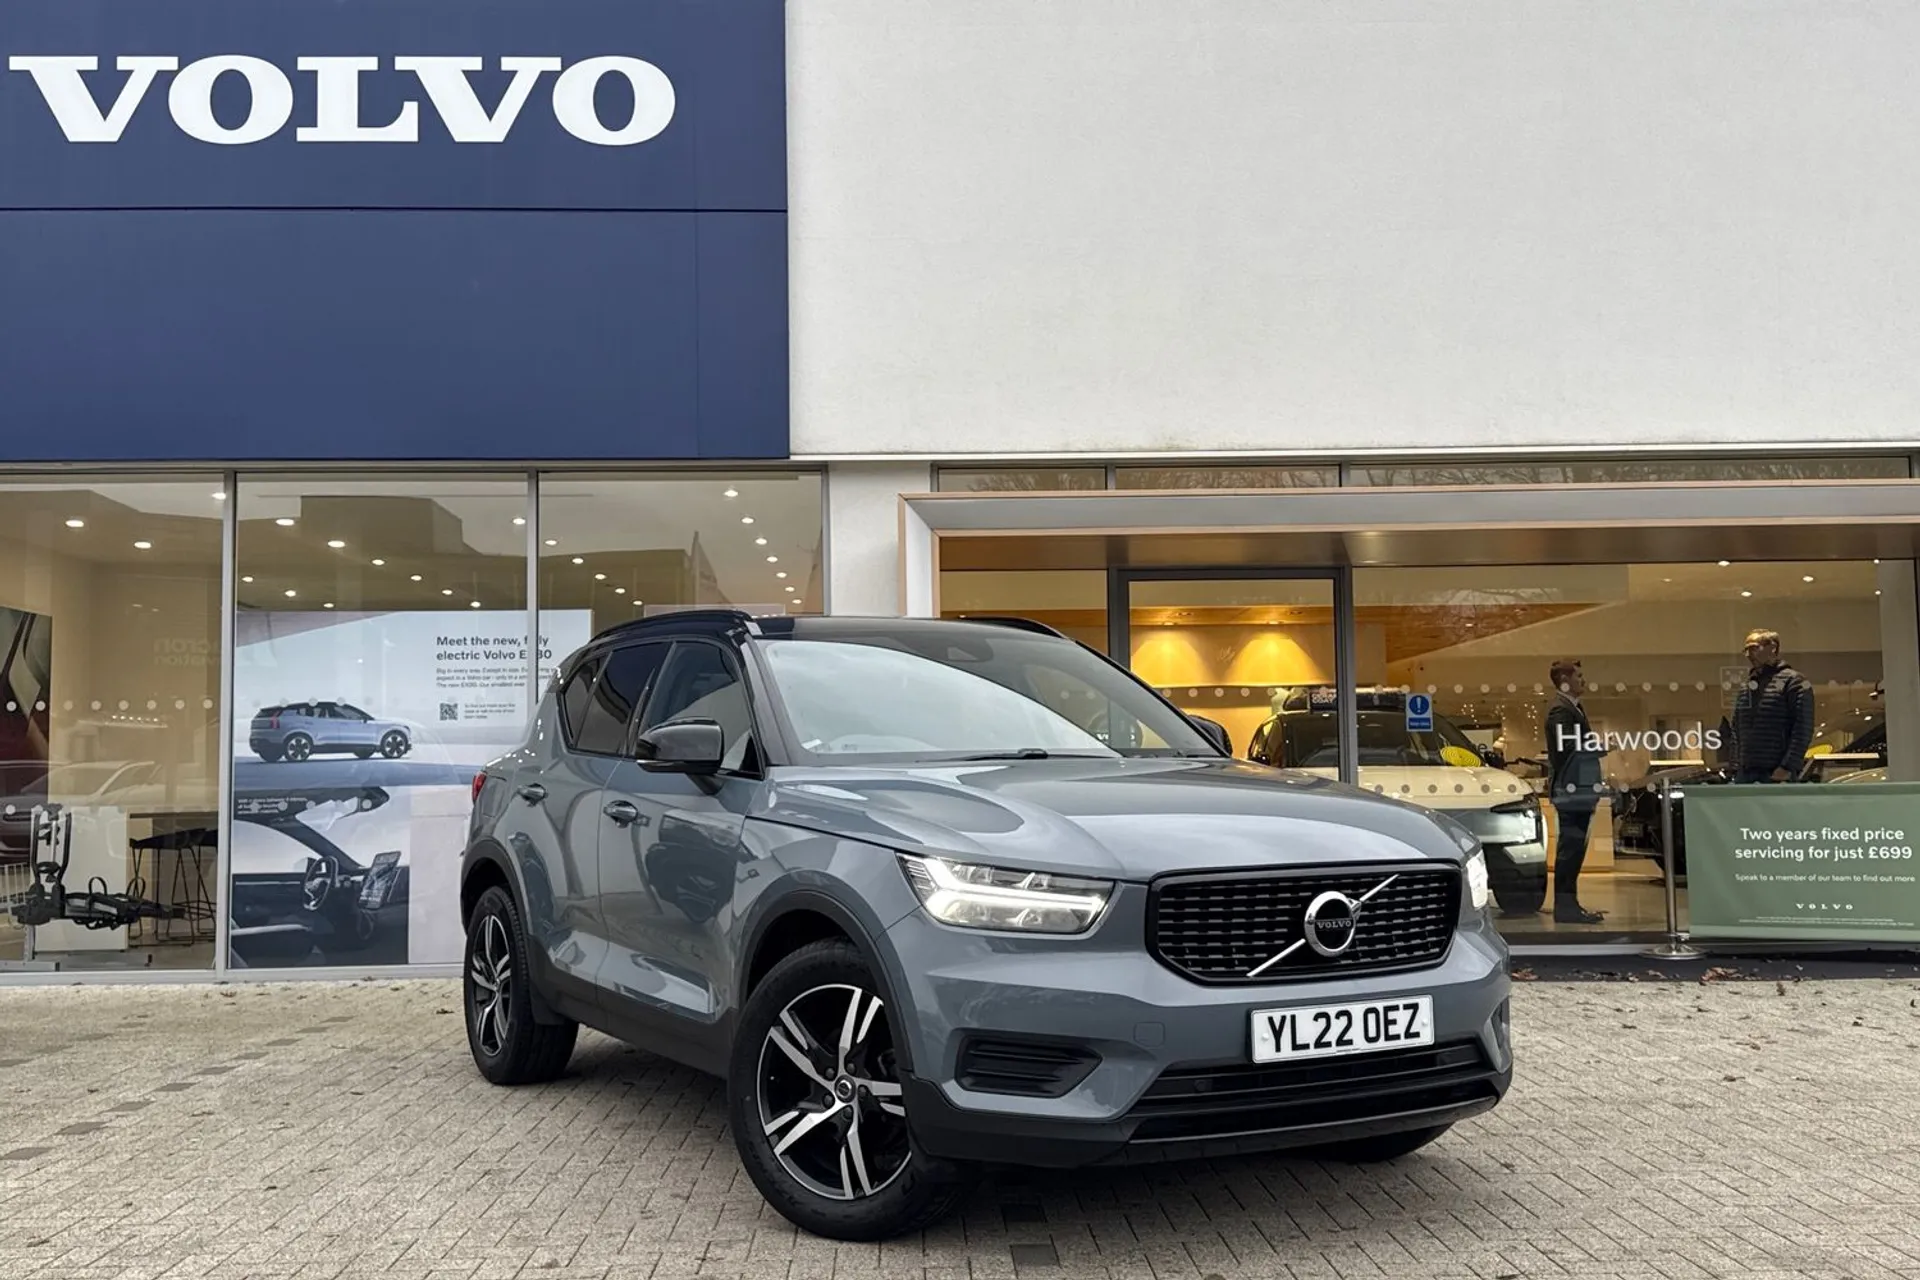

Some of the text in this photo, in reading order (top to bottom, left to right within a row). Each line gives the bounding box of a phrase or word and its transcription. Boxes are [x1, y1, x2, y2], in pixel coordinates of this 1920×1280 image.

[8, 55, 676, 146] VOLVO
[436, 635, 549, 648] Meet the new, fly
[436, 649, 552, 661] electric Volvo E30
[1556, 721, 1722, 752] Harwoods
[1740, 826, 1905, 843] Two years fixed price
[1734, 845, 1913, 862] servicing for just £699
[1735, 873, 1758, 882] Speak
[1759, 874, 1768, 882] to
[1775, 874, 1807, 882] member
[1807, 873, 1817, 882] of
[1831, 874, 1852, 882] team
[1862, 874, 1878, 883] find
[1879, 875, 1893, 883] out
[1316, 920, 1352, 929] VOLVO
[1267, 1002, 1421, 1053] YL22 OEZ
